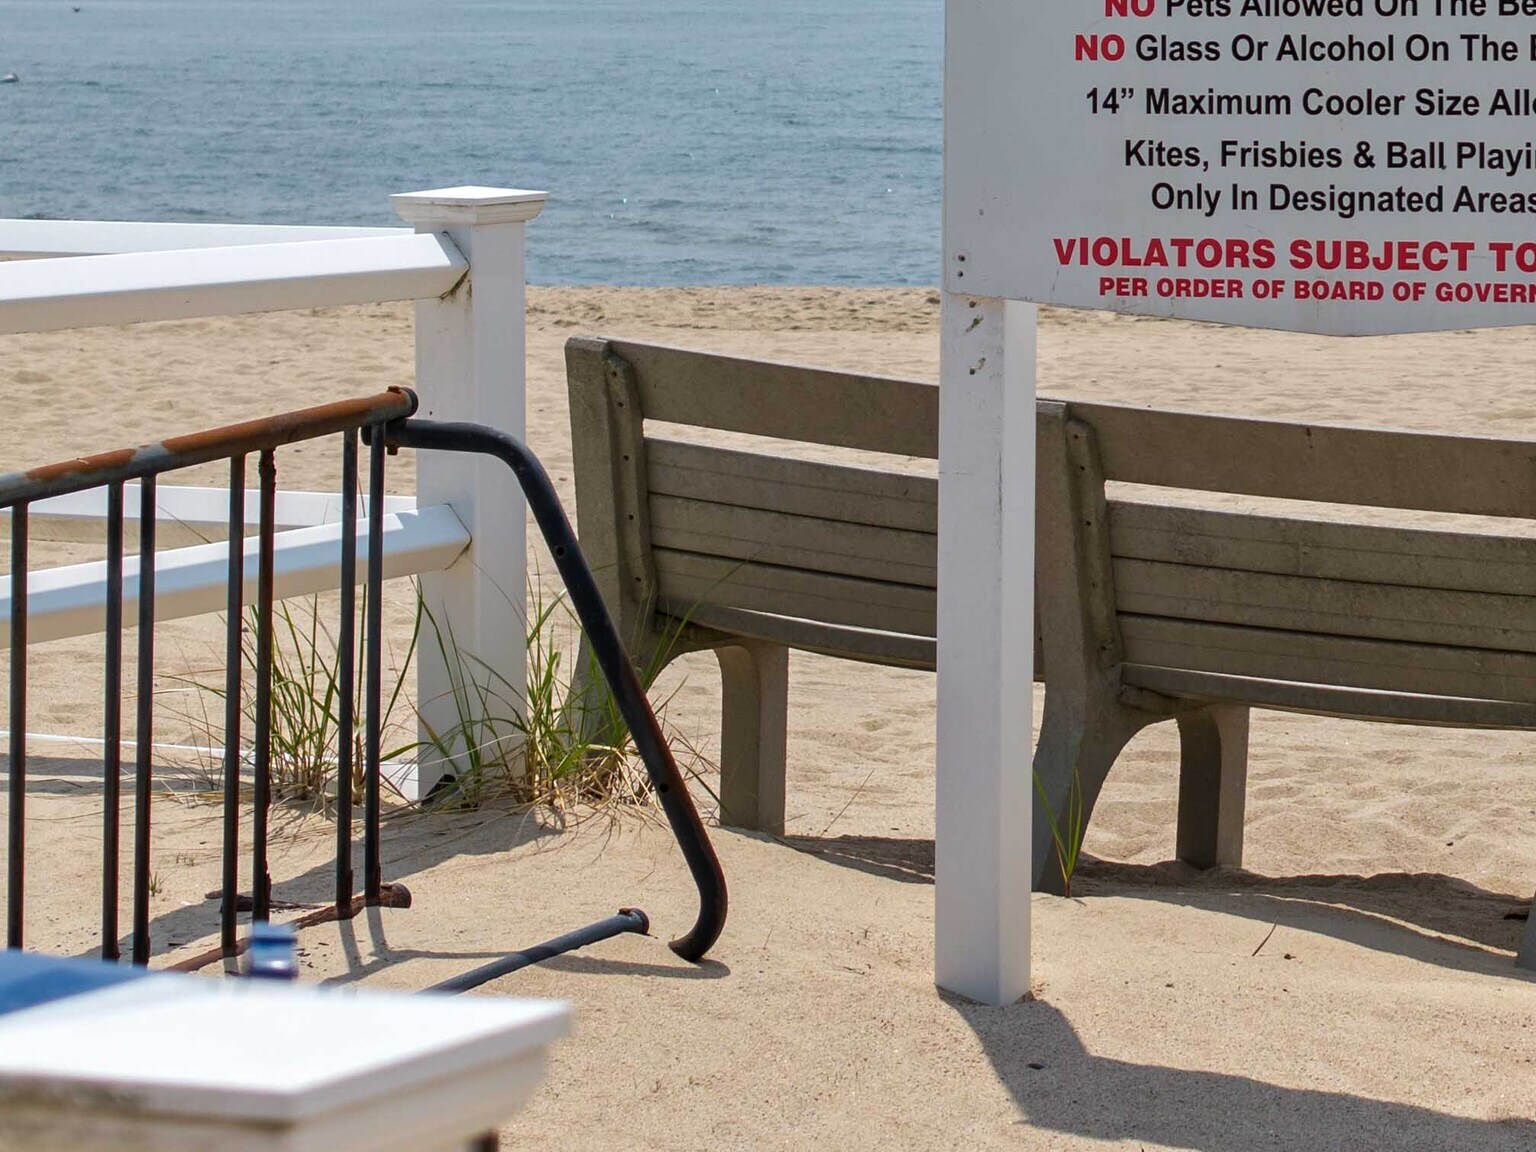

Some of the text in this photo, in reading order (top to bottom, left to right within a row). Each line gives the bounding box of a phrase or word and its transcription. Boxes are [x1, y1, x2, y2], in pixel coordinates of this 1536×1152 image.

[1075, 33, 1125, 62] NO
[1135, 34, 1221, 62] Glass
[1231, 33, 1269, 62] Or
[1275, 34, 1394, 62] Alcohol
[1405, 33, 1449, 62] On
[1459, 33, 1519, 62] The
[1086, 87, 1134, 115] 14”
[1146, 87, 1291, 115] Maximum
[1302, 87, 1406, 116] Cooler
[1414, 88, 1480, 117] Size
[1125, 139, 1209, 173] Kites,
[1221, 140, 1343, 169] Frisbies
[1353, 140, 1376, 169] &
[1387, 141, 1447, 171] Ball
[1151, 182, 1222, 218] Only
[1232, 183, 1258, 211] In
[1269, 183, 1444, 219] Designated
[1053, 236, 1276, 269] VIOLATORS
[1289, 239, 1475, 272] SUBJECT
[1099, 276, 1148, 297] PER
[1156, 277, 1243, 299] ORDER
[1251, 279, 1286, 299] OF
[1294, 280, 1384, 301] BOARD
[1392, 281, 1427, 302] OF
